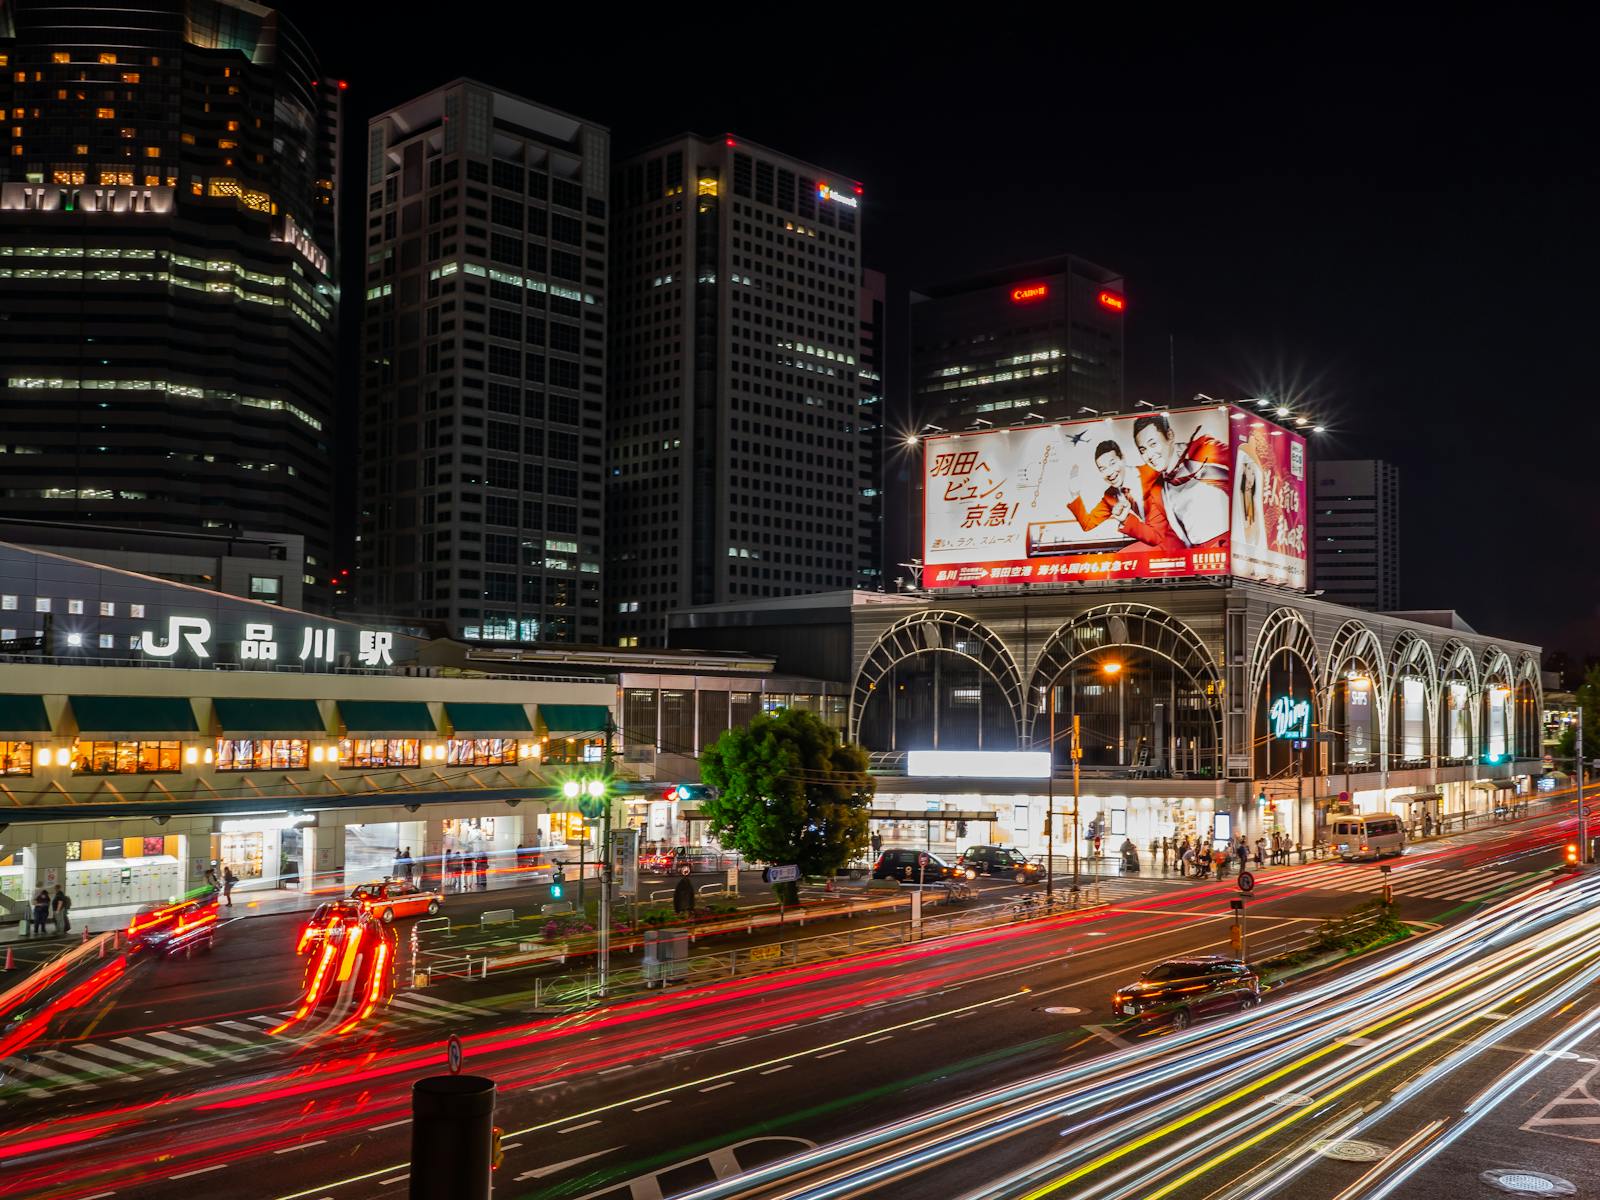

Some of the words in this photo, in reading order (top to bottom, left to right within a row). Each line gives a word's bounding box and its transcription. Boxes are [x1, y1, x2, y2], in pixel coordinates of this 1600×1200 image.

[1014, 287, 1045, 299] Canon
[930, 451, 990, 477] 羽田へ
[943, 478, 1007, 501] ビュン。
[142, 616, 212, 658] JR
[241, 623, 394, 666] 品川駅
